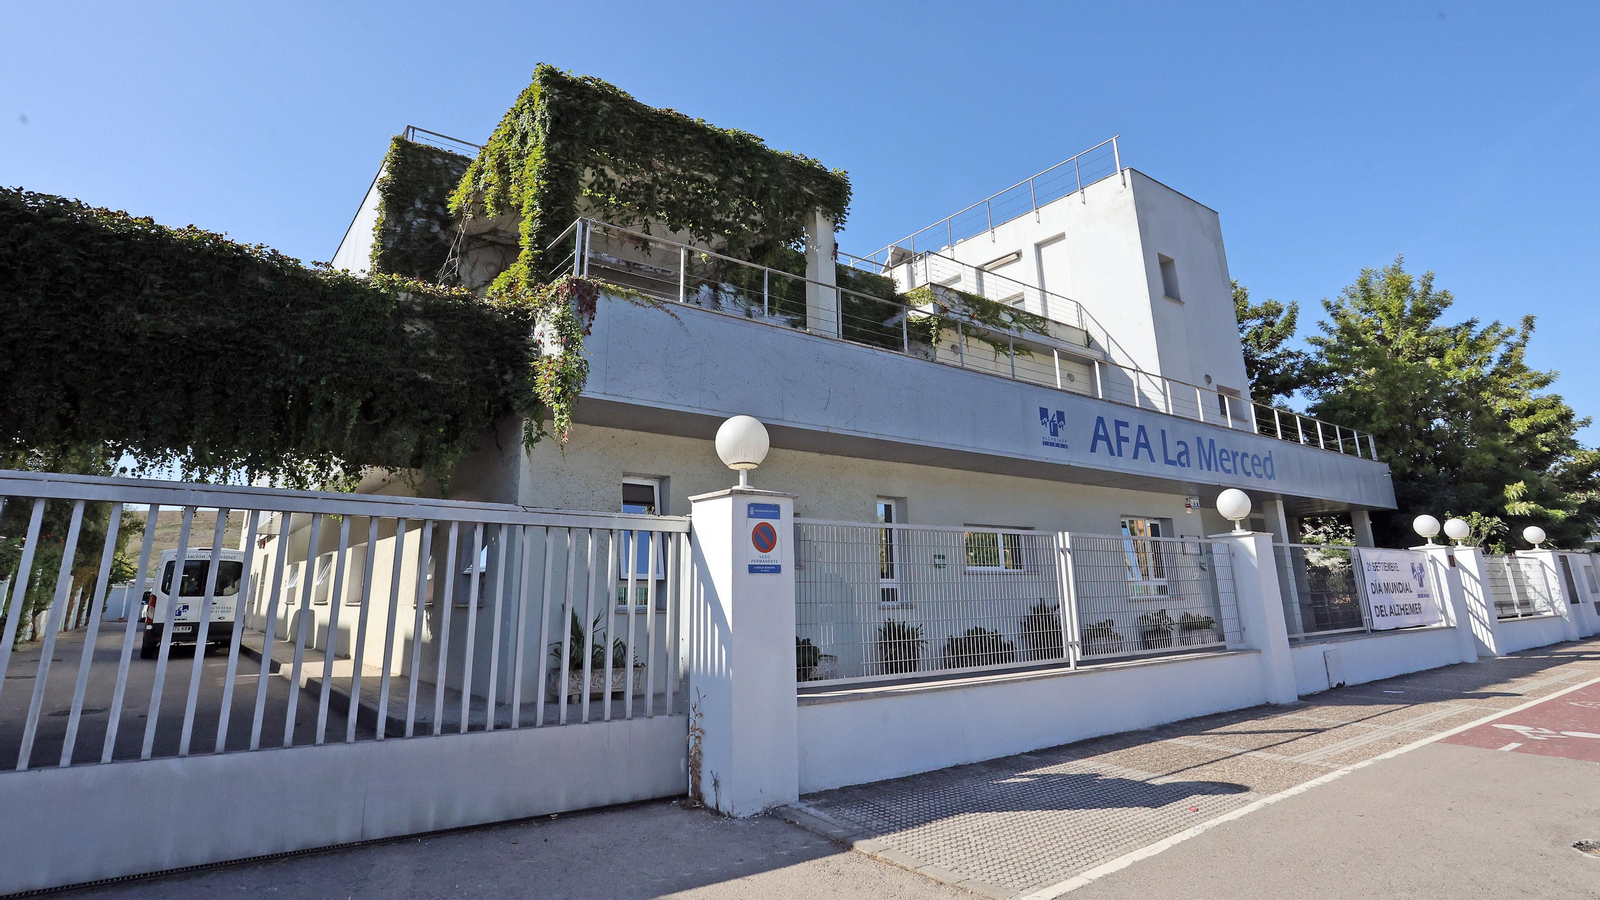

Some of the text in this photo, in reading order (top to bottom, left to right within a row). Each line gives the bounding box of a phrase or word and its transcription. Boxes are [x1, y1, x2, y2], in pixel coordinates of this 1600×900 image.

[1090, 416, 1276, 481] AFA La Merced
[1366, 562, 1400, 572] 21 SEPTIEMBRE
[1371, 580, 1413, 595] DÍA MUNDIAL
[1374, 603, 1422, 618] DEL ALZHEIMER
